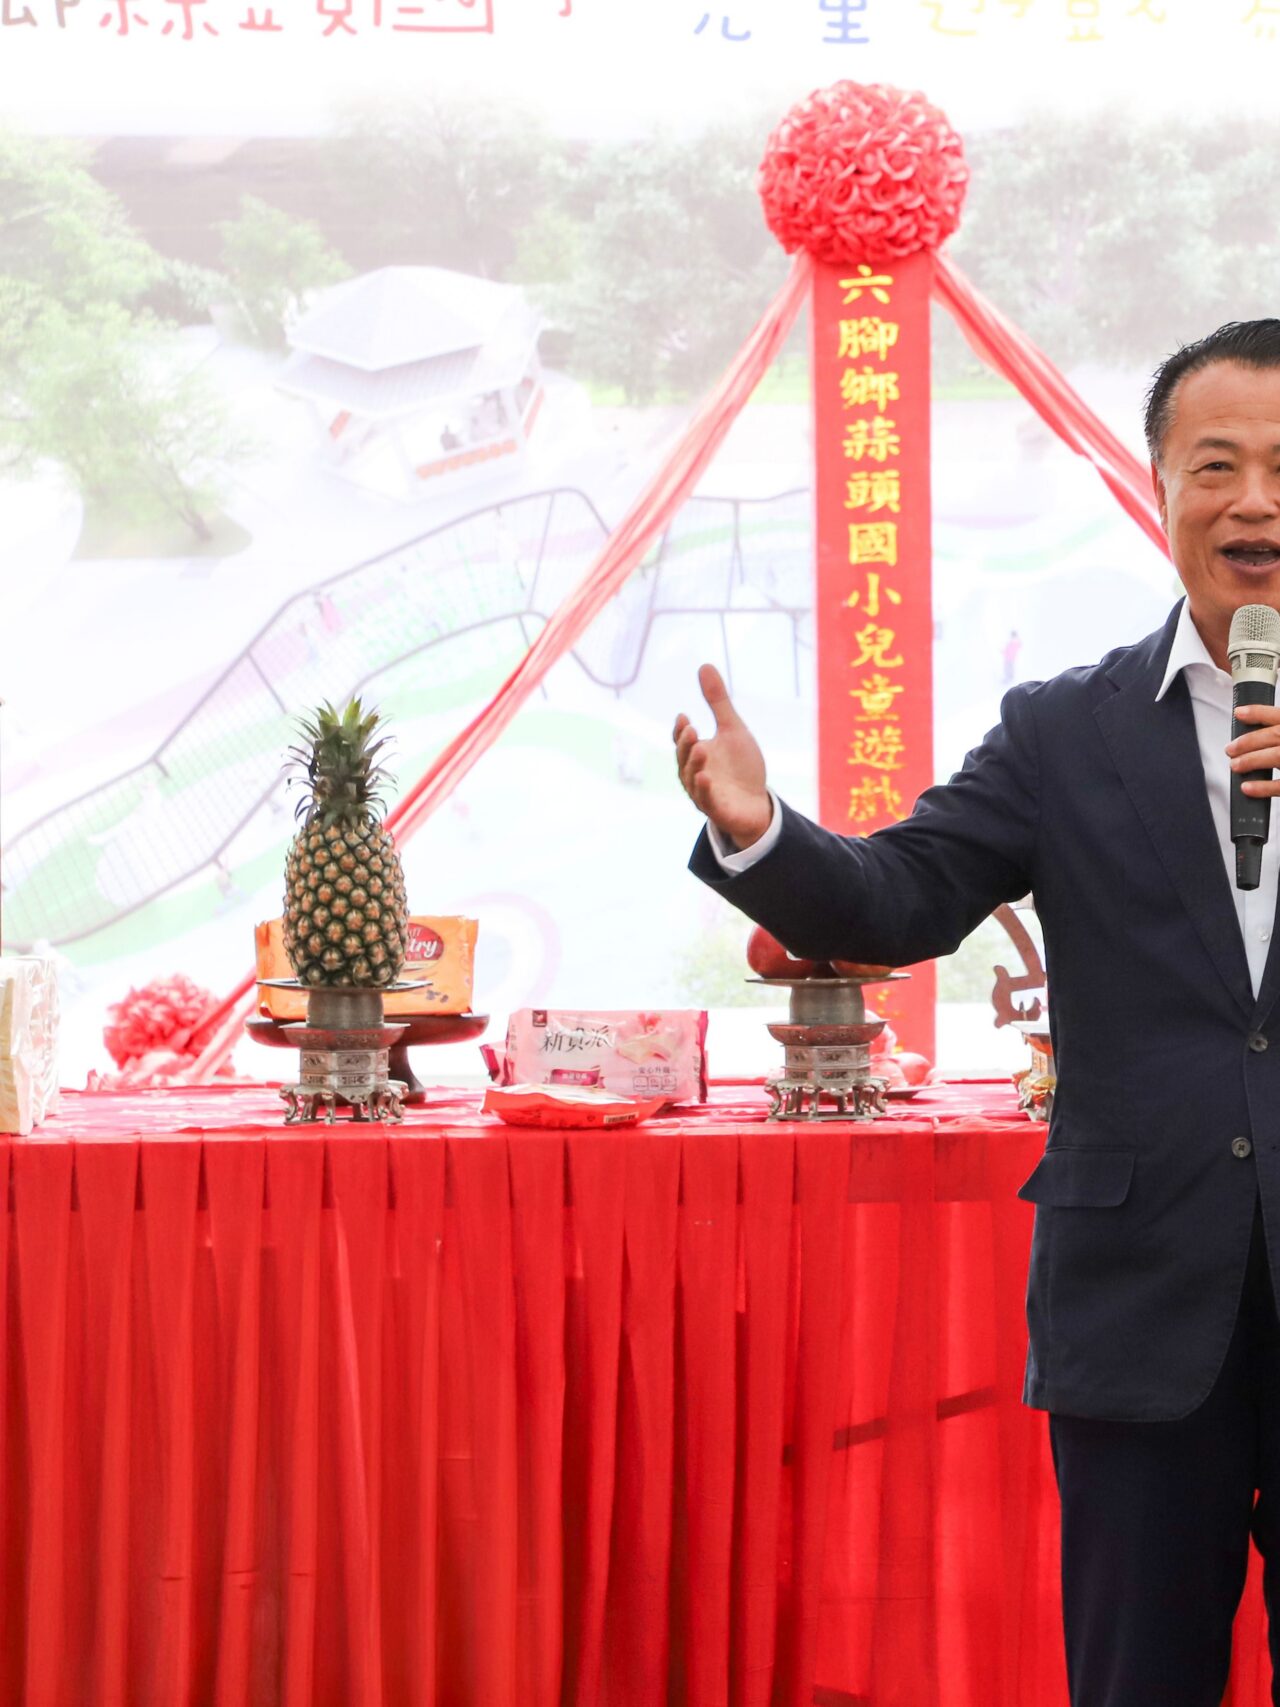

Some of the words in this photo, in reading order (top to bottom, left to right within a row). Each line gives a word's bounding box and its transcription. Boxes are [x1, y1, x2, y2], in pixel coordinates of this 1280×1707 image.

[838, 264, 907, 839] 六腳鄉蒜頭國小兒童遊戲
[410, 939, 437, 957] try
